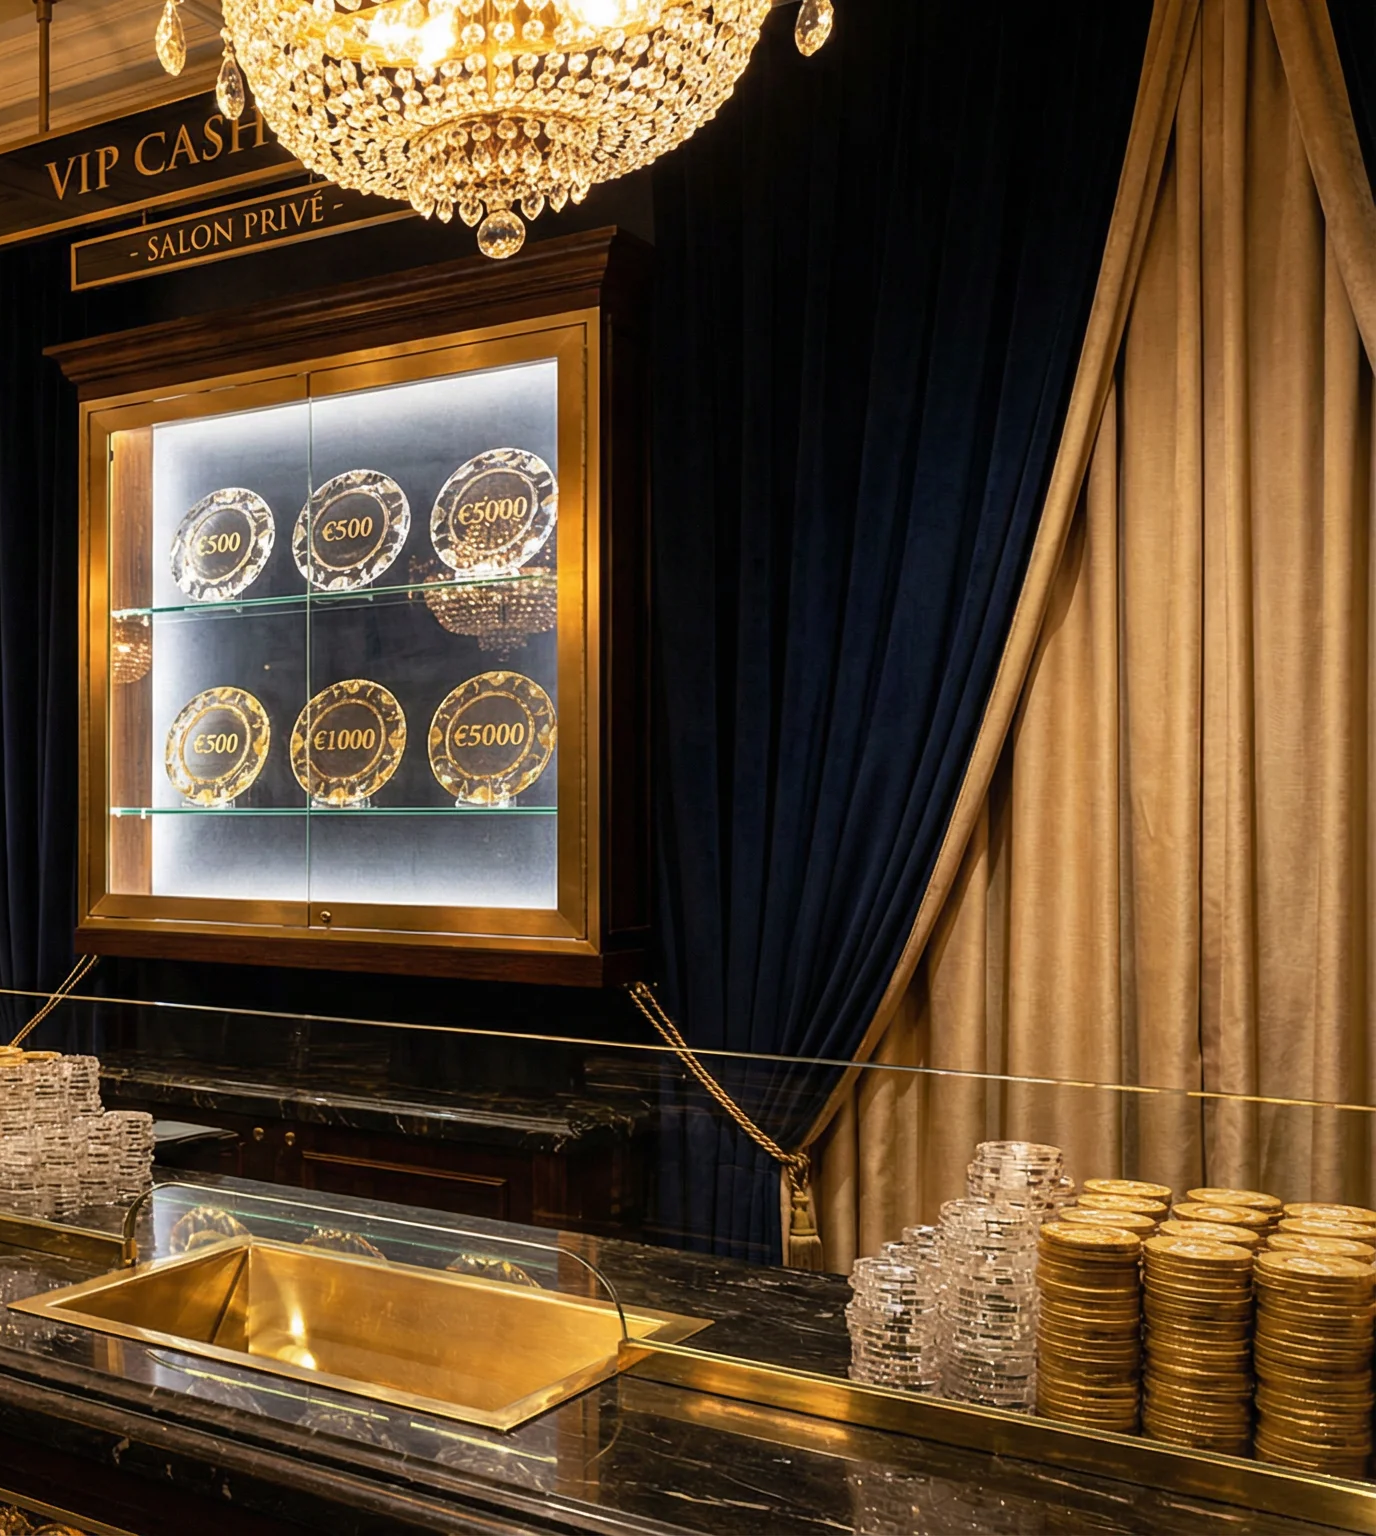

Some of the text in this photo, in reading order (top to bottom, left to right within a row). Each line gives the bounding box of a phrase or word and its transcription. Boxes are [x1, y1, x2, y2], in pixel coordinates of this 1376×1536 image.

[45, 105, 270, 201] VIP CASH
[147, 217, 233, 262] SALON
[242, 189, 324, 239] PRIVÉ
[457, 496, 528, 526] €5000
[322, 516, 373, 542] €500
[197, 531, 241, 557] €500
[193, 733, 239, 754] €500
[314, 728, 376, 750] €1000
[454, 722, 525, 747] €5000
